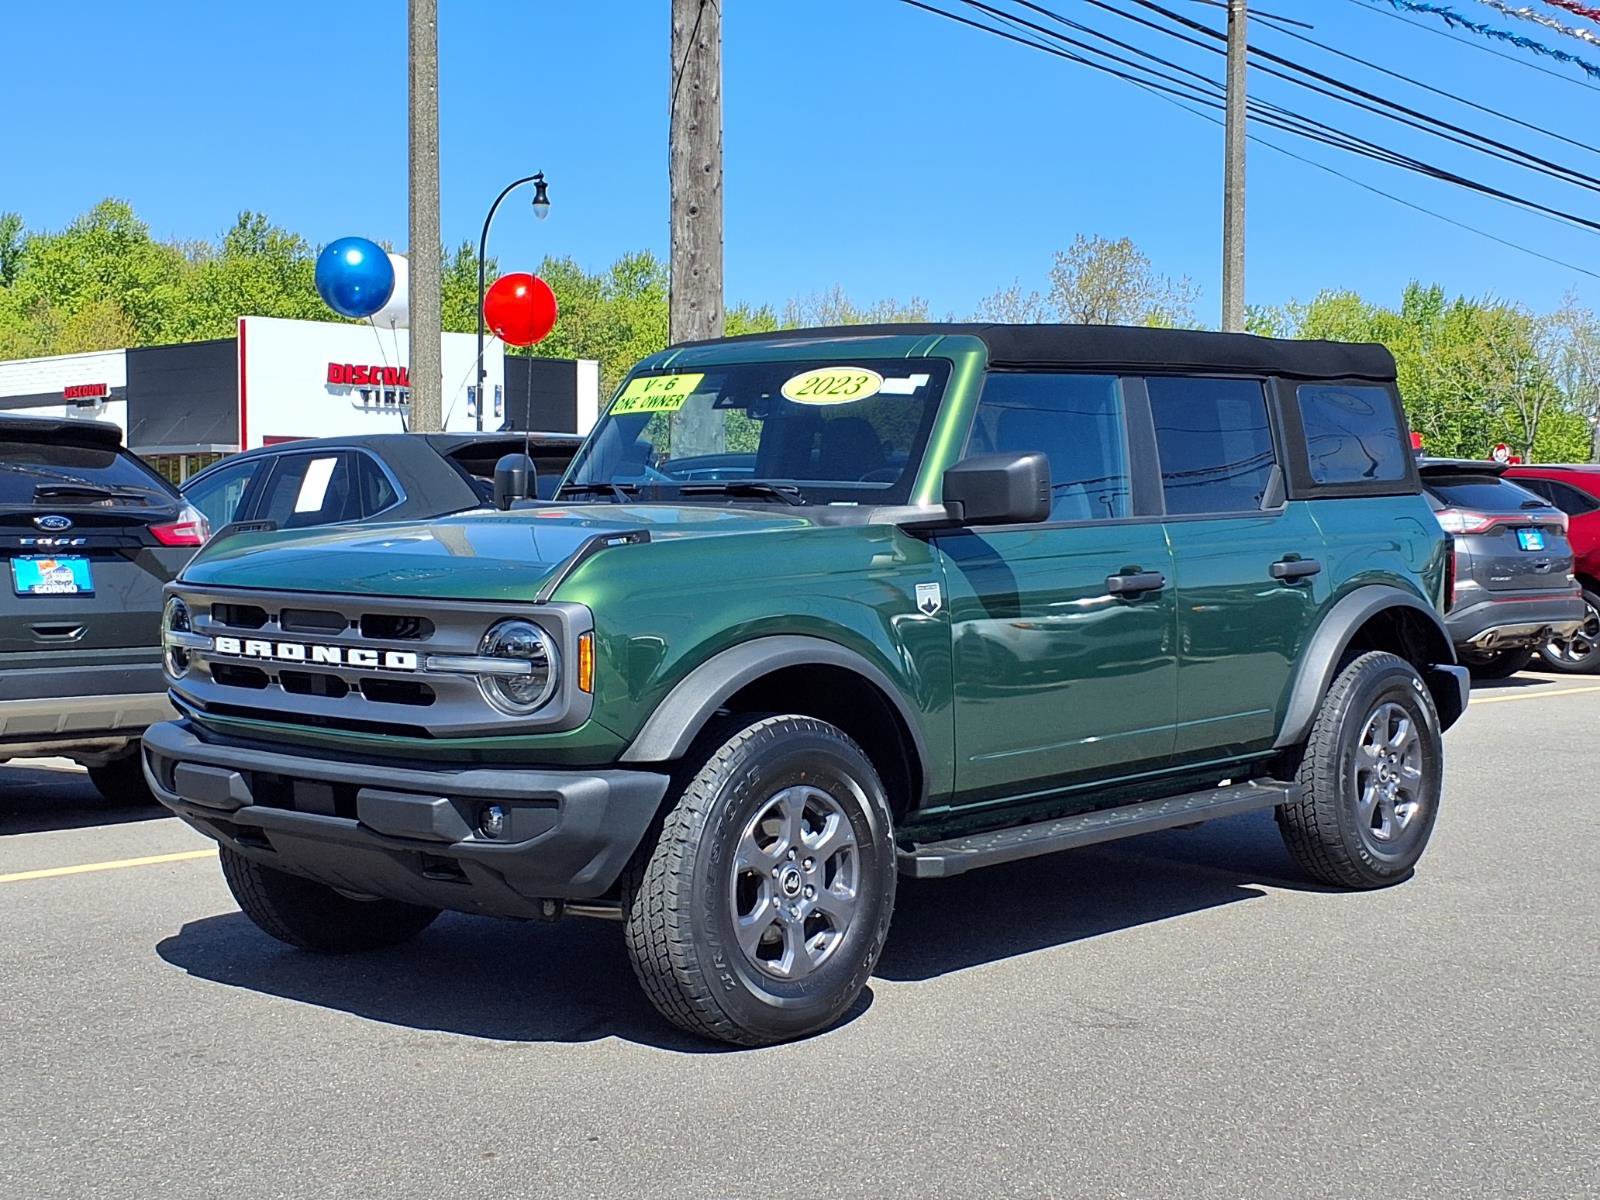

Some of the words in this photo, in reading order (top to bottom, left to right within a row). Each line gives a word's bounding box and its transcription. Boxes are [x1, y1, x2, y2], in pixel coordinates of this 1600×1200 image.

[327, 362, 410, 387] DISCOU
[64, 383, 107, 398] DISCOUNT
[796, 376, 869, 396] 2023
[615, 397, 640, 411] ONE
[640, 394, 684, 409] OWNER
[215, 636, 418, 670] BRONCO
